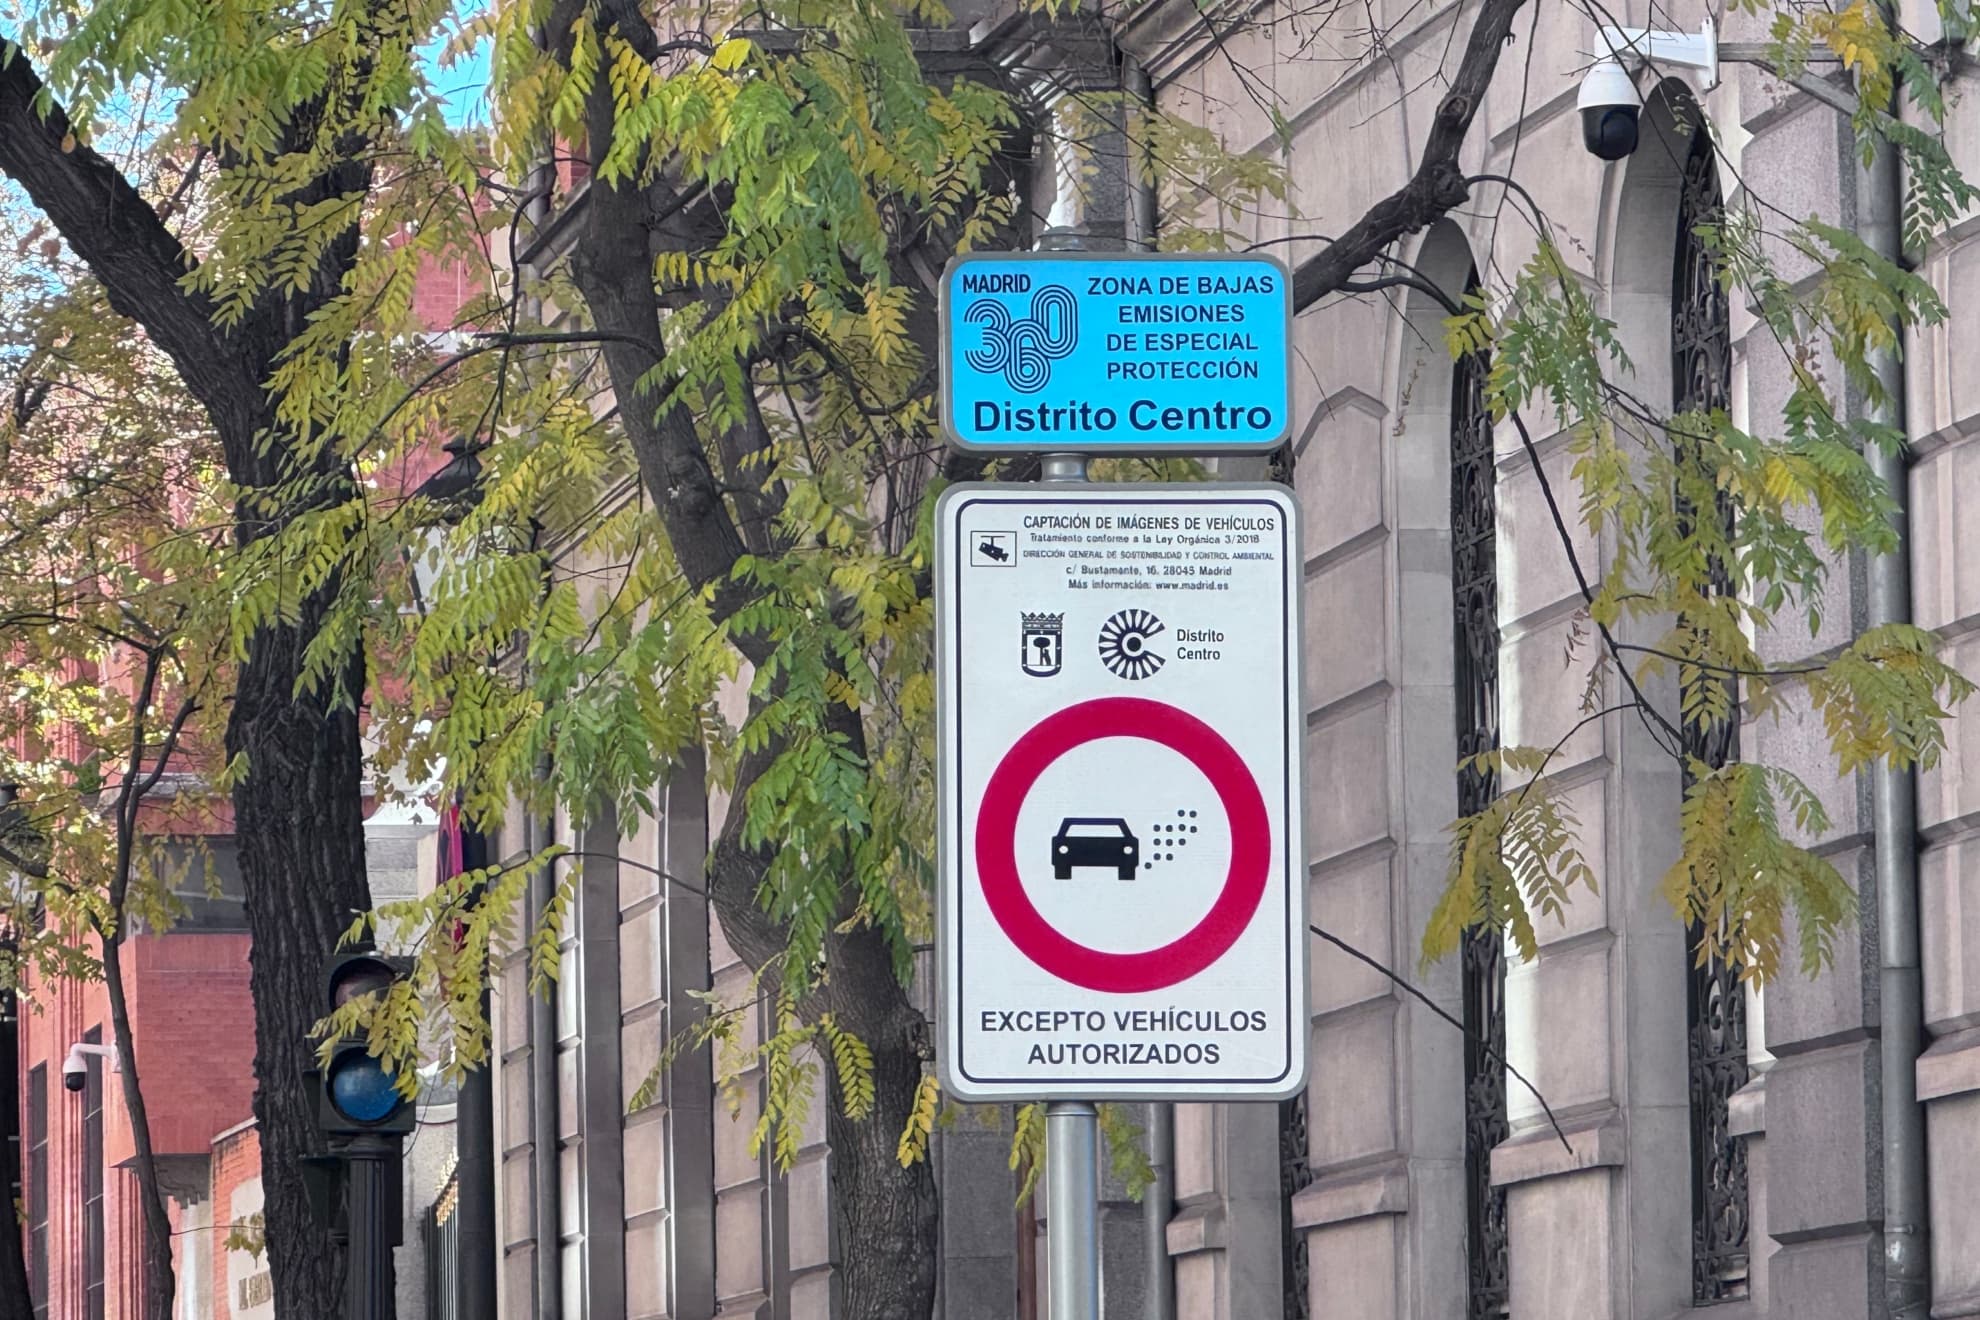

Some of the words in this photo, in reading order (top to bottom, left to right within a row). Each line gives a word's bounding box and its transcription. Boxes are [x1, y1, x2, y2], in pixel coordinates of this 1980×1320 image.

[963, 274, 1031, 293] MADRID
[1088, 277, 1152, 295] ZONA
[1159, 277, 1190, 295] DE
[1198, 276, 1274, 294] BAJAS
[1119, 305, 1245, 323] EMISIONES
[964, 285, 1078, 394] 360
[1107, 334, 1137, 351] DE
[1145, 333, 1258, 351] ESPECIAL
[1107, 357, 1258, 380] PROTECCIÓN
[974, 401, 1117, 432] Distrito
[1129, 400, 1272, 431] Centro
[1023, 513, 1090, 529] CAPTACIÓN
[1096, 517, 1112, 529] DE
[1117, 514, 1179, 530] IMÁGENES
[1185, 517, 1200, 530] DE
[1206, 515, 1275, 531] VEHÍCULOS
[1030, 533, 1083, 543] Tratamiento
[1087, 534, 1129, 543] conforme
[1143, 534, 1152, 544] la
[1156, 535, 1173, 545] Ley
[1177, 534, 1221, 546] Orgánica
[1225, 535, 1260, 544] 3/2018
[1068, 551, 1104, 559] GENERAL
[1107, 551, 1117, 559] DE
[1185, 552, 1190, 560] Y
[1193, 552, 1230, 560] CONTROL
[1232, 552, 1275, 561] AMBIENTAL
[1066, 564, 1077, 575] c/
[1081, 565, 1142, 576] Bustamante,
[1163, 566, 1196, 575] 28045
[1199, 566, 1232, 576] Madrid
[1068, 579, 1088, 589] Más
[1155, 580, 1229, 591] www.madrid.es
[1177, 629, 1224, 642] Distrito
[1177, 647, 1221, 660] Centro
[981, 1011, 1106, 1032] EXCEPTO
[1114, 1006, 1268, 1032] VEHÍCULOS
[1027, 1043, 1221, 1065] AUTORIZADOS
